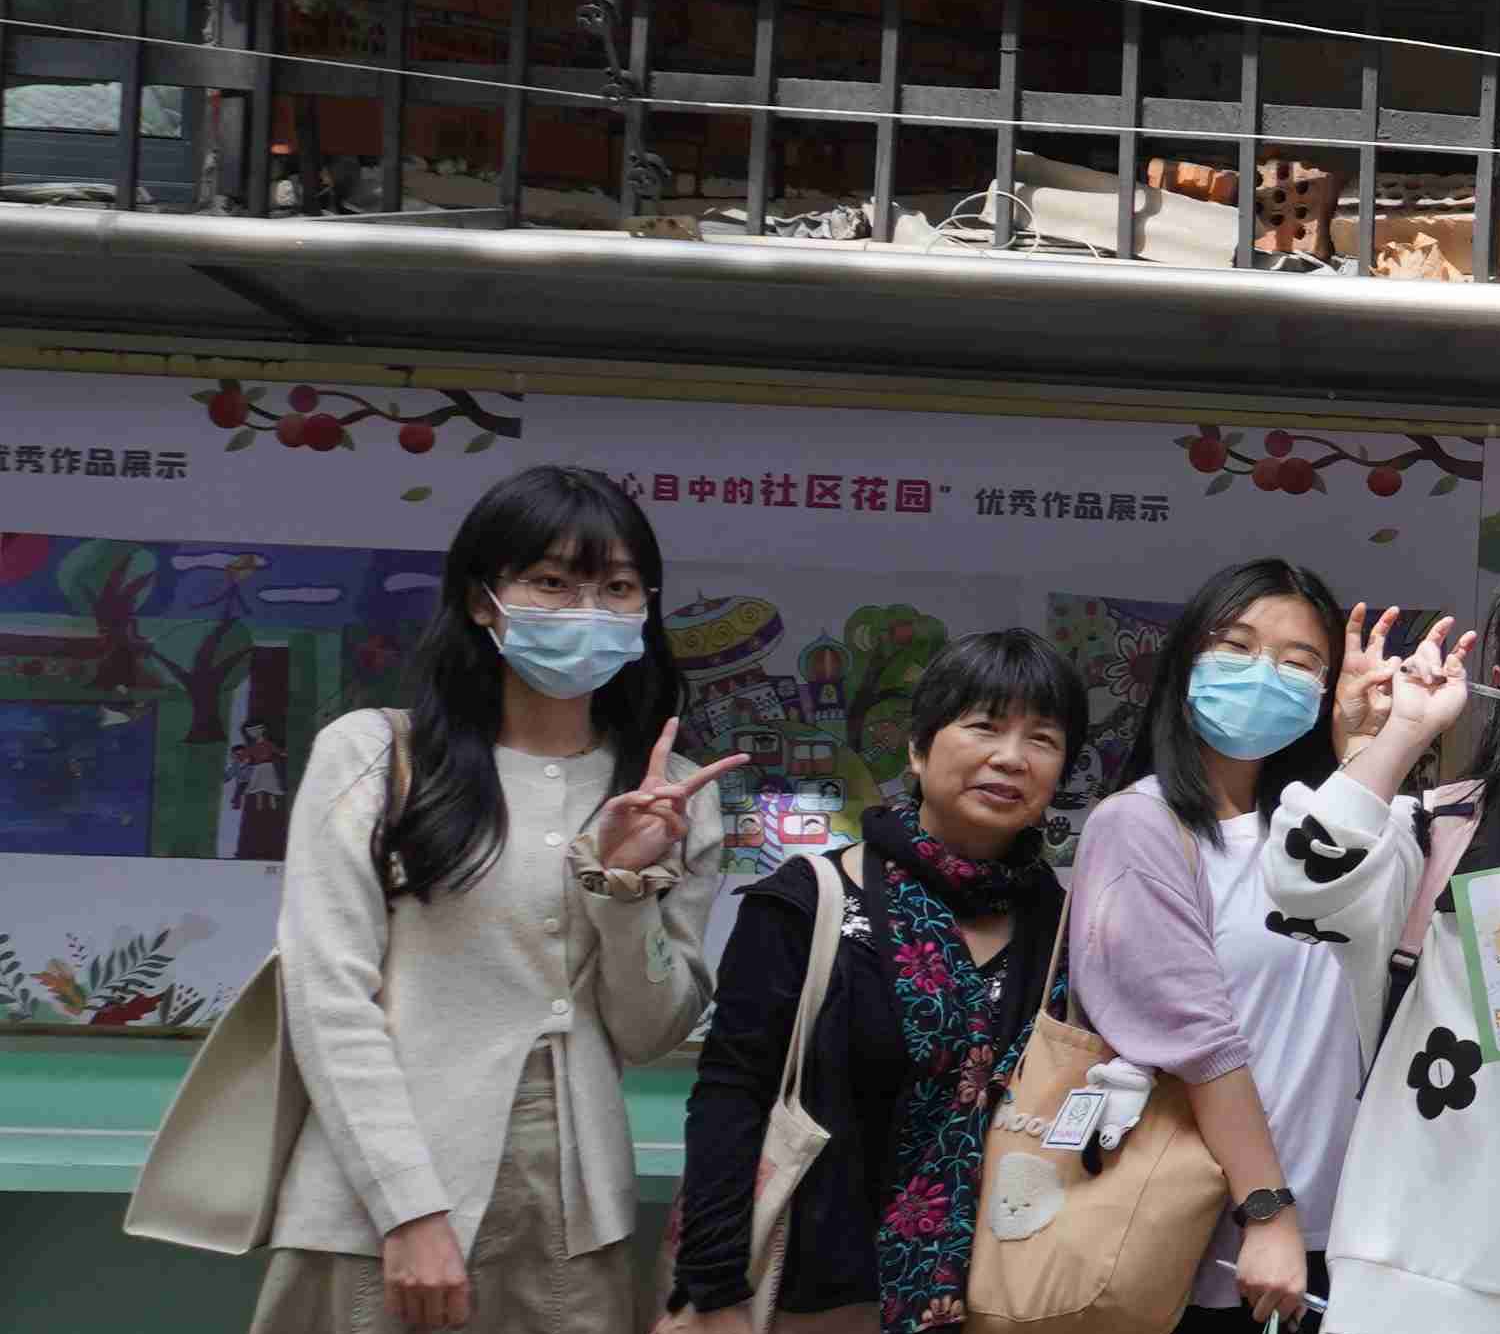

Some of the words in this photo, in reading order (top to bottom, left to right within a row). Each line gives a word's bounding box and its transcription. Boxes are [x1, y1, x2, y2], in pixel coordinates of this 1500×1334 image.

[975, 487, 1170, 522] 优秀作品展示
